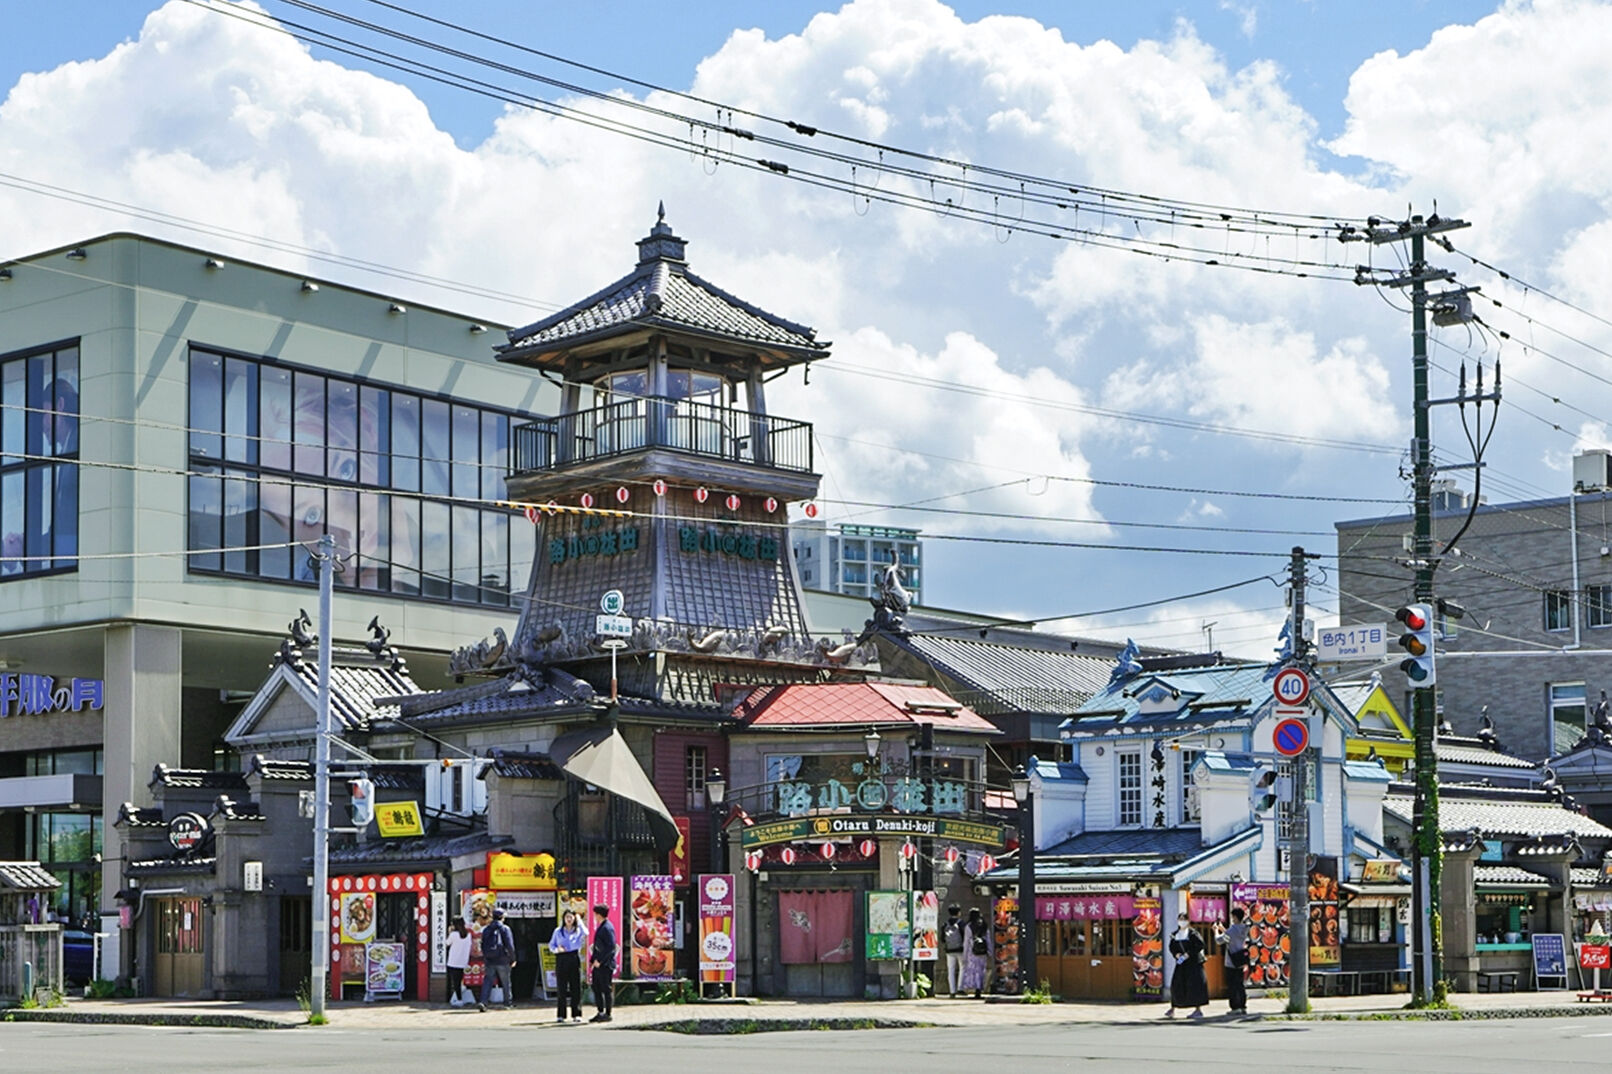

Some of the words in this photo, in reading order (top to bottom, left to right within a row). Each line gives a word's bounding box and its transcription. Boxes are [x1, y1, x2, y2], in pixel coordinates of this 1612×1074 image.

[1323, 628, 1381, 647] 色内1丁目
[1361, 645, 1366, 653] 1
[1281, 678, 1302, 696] 40
[833, 820, 869, 831] Otaru
[876, 819, 936, 834] Denuki-koji
[707, 940, 728, 951] 35cm
